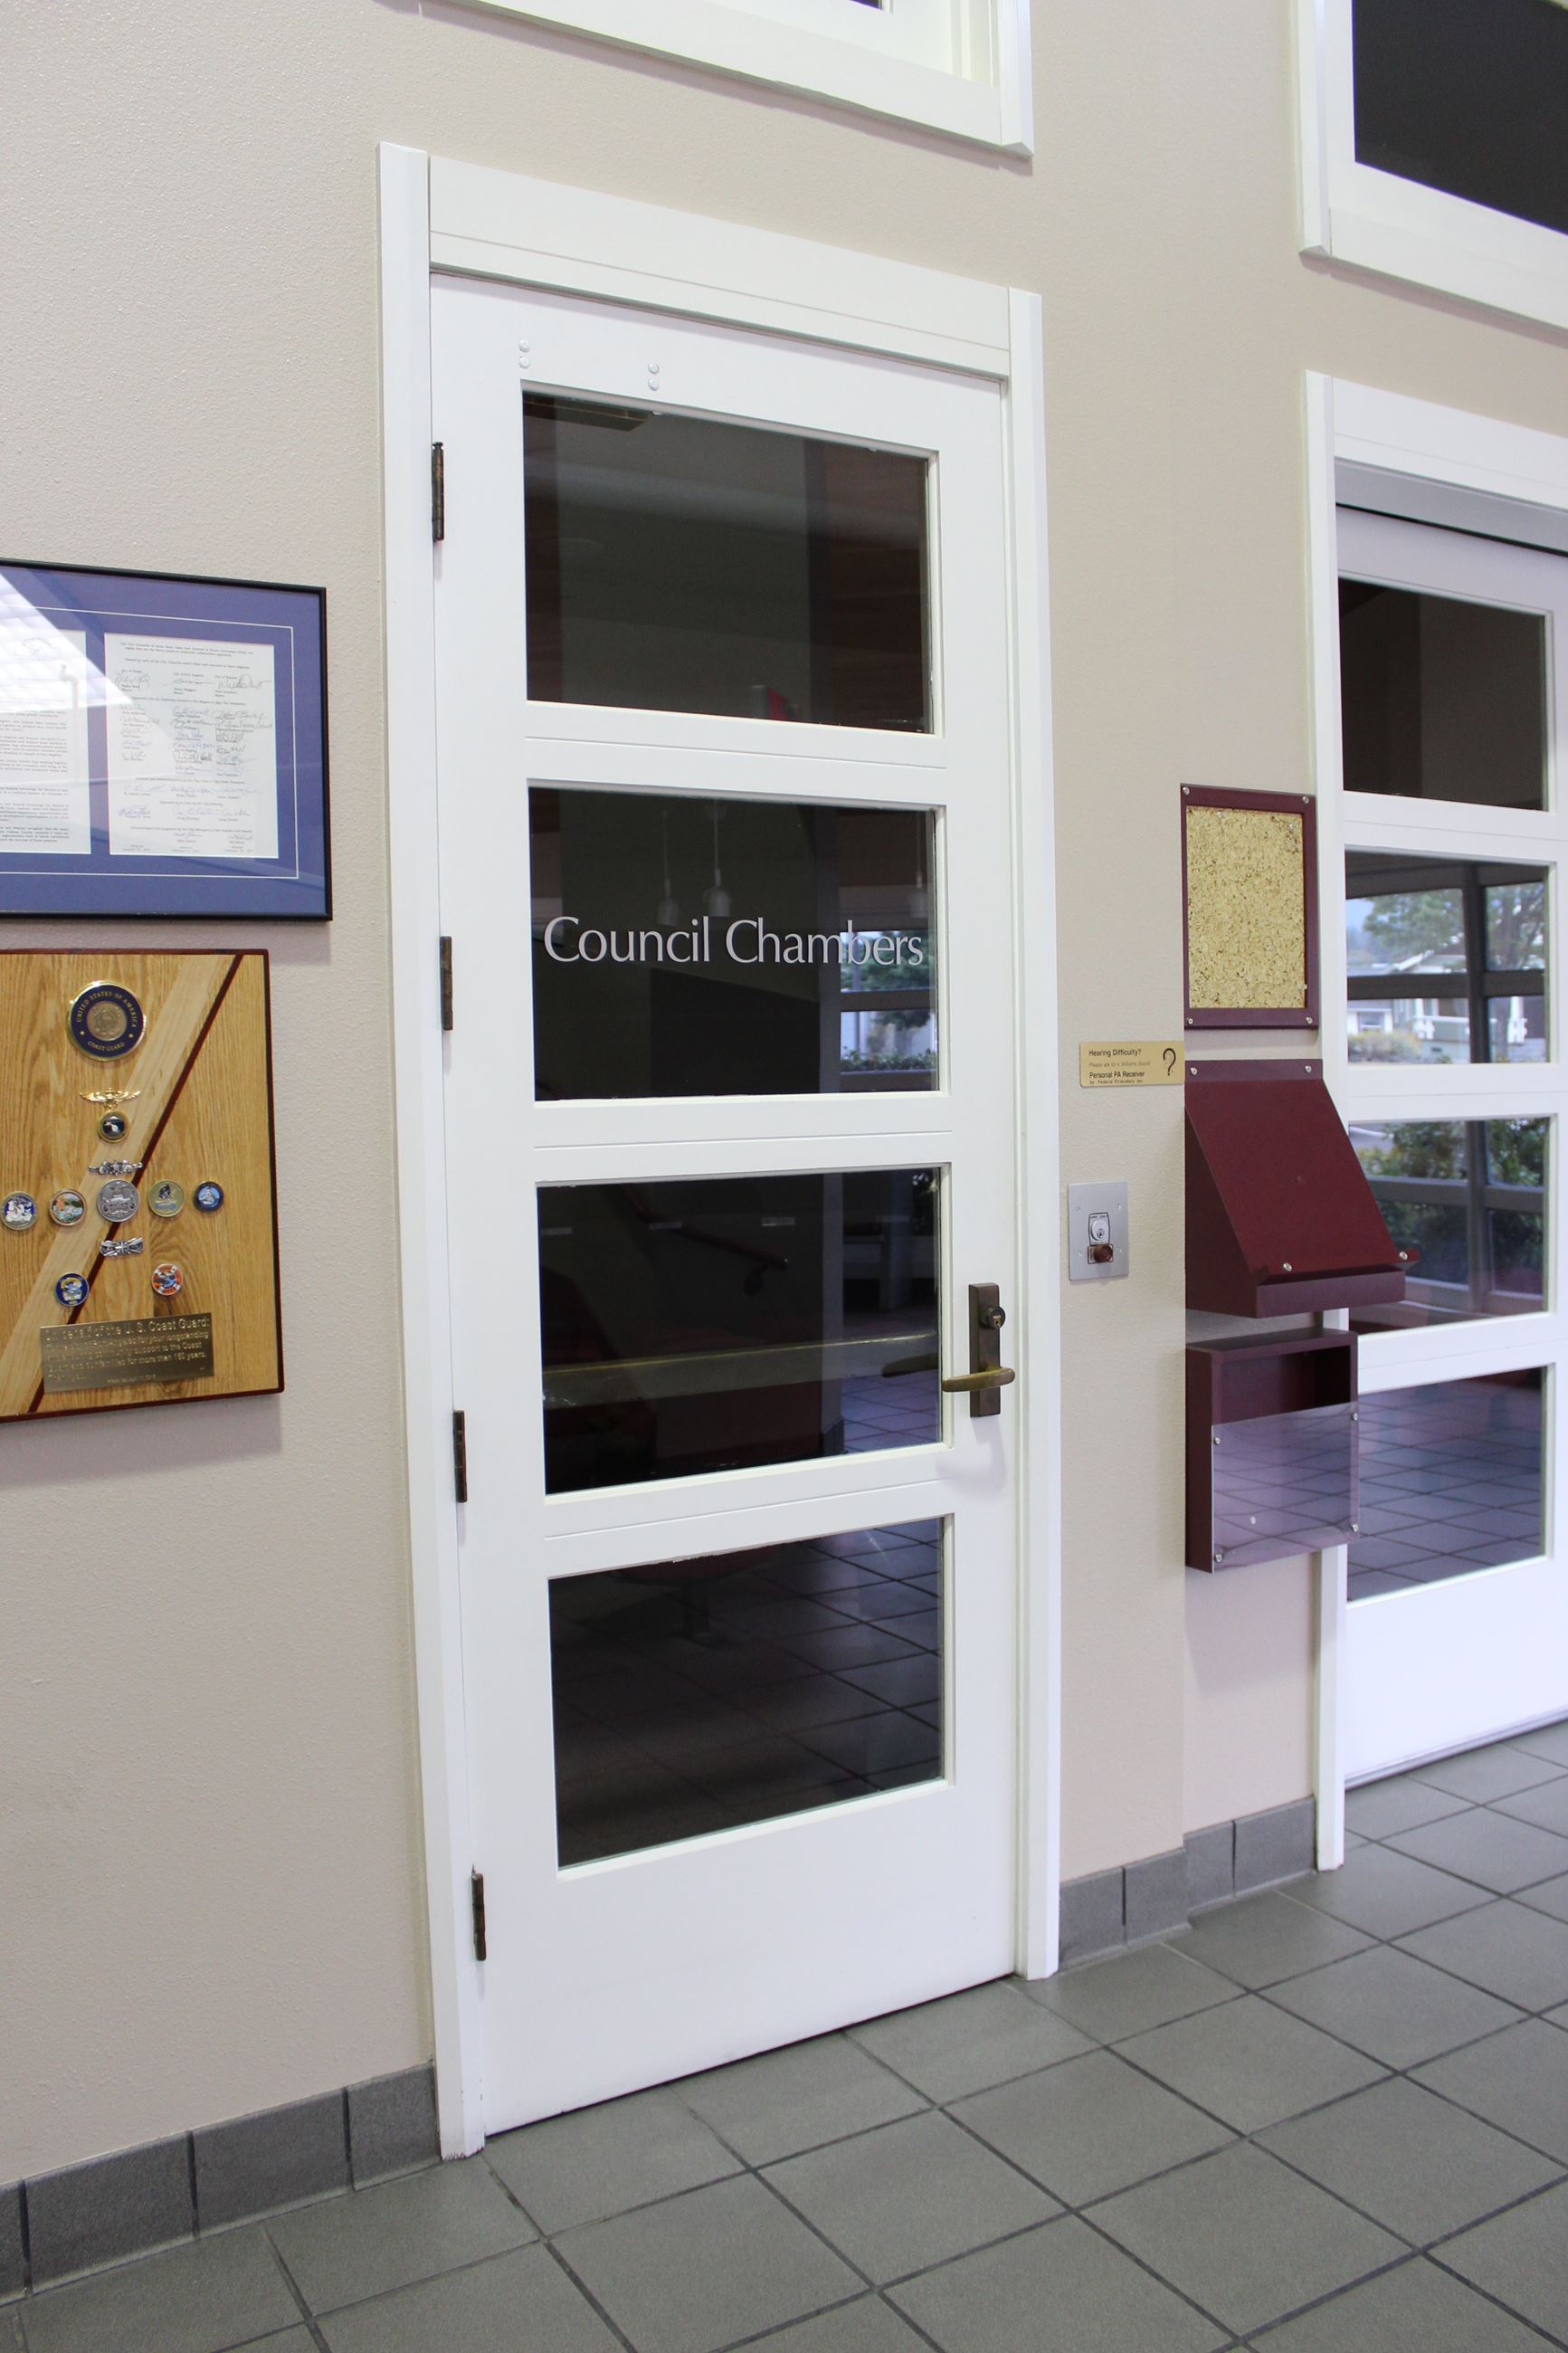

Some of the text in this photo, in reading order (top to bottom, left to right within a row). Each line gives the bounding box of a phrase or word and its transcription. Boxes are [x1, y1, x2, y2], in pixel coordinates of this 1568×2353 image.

[544, 915, 924, 967] Council Chambers
[76, 998, 90, 1023] UNITED
[90, 991, 113, 1000] STATES
[123, 998, 138, 1028] AMERICA
[87, 1041, 125, 1052] COAST GUARD
[1088, 1048, 1142, 1057] Hearing Difficulty?
[1122, 1070, 1145, 1078] Receiver
[137, 1320, 147, 1333] S.
[148, 1319, 176, 1332] Coast
[178, 1317, 211, 1329] Guard:
[182, 1341, 203, 1349] Coast
